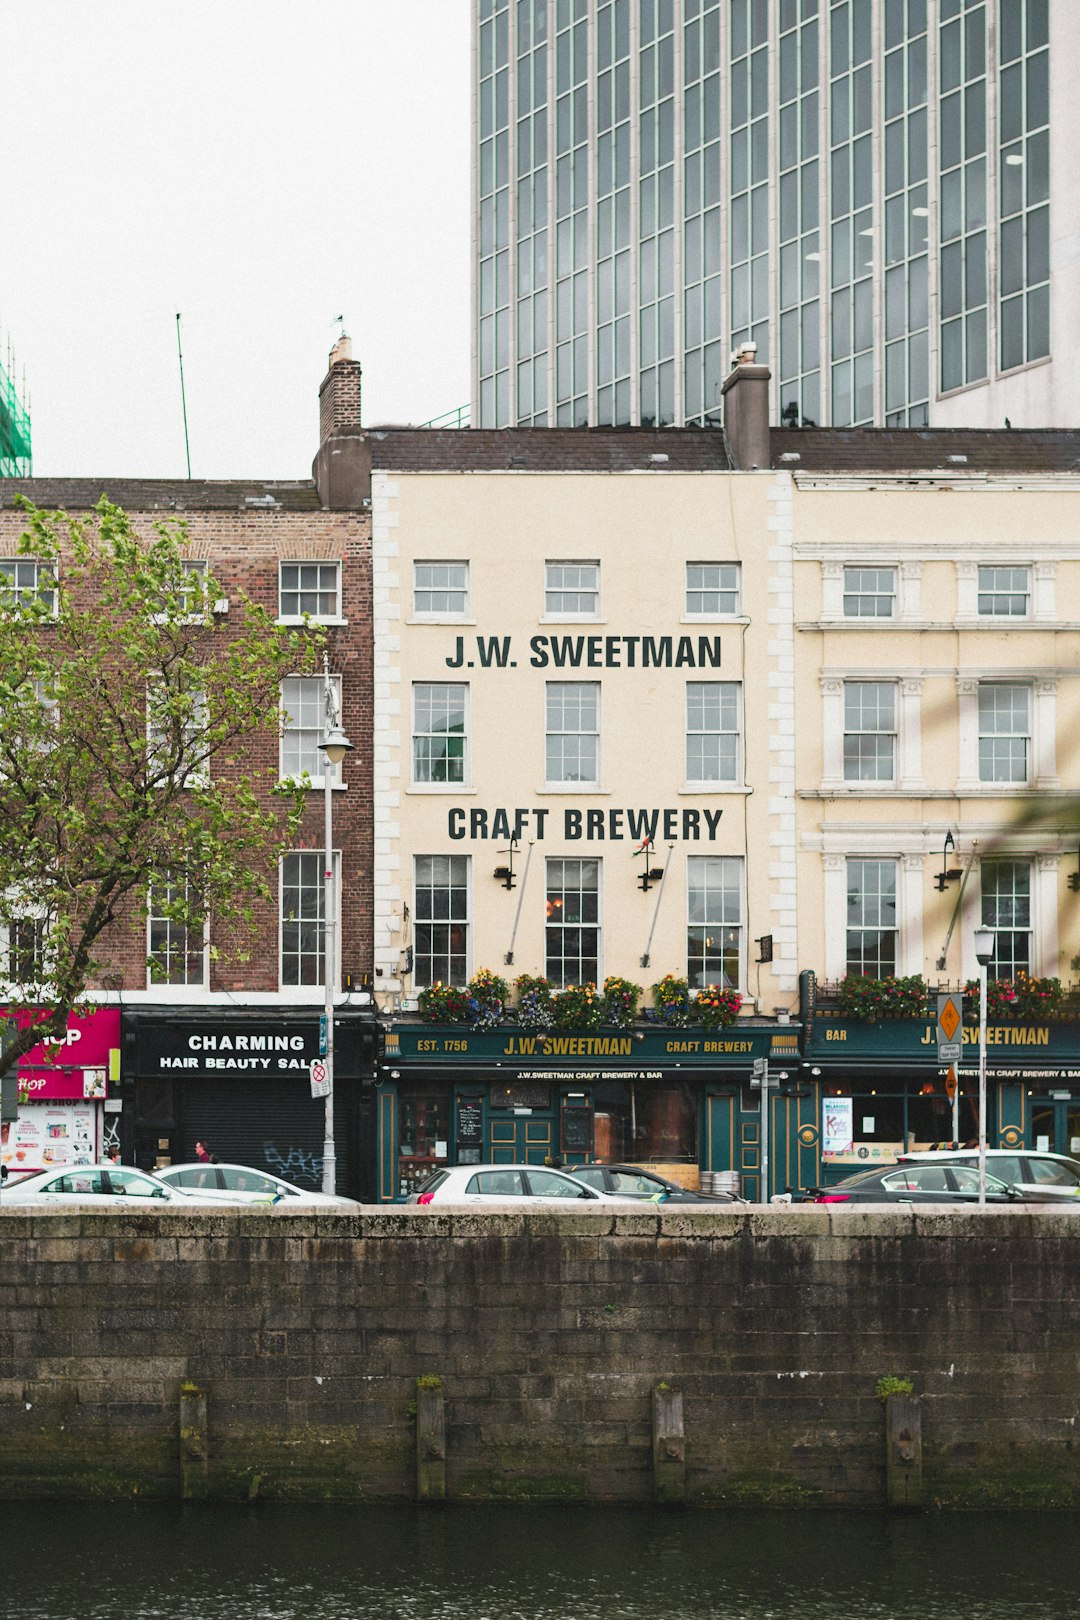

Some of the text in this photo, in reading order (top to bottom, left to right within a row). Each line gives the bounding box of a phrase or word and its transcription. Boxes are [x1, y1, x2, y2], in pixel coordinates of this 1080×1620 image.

[446, 636, 722, 668] J.W. SWEETMAN
[448, 808, 723, 841] CRAFT BREWERY
[826, 1029, 847, 1041] BAR
[188, 1035, 305, 1051] CHARMING
[417, 1040, 468, 1051] EST. 1756
[503, 1037, 632, 1055] J.W. SWEETMAN
[666, 1041, 753, 1052] CRAFT BREWERY
[160, 1058, 327, 1069] HAIR BEAUTY SALO
